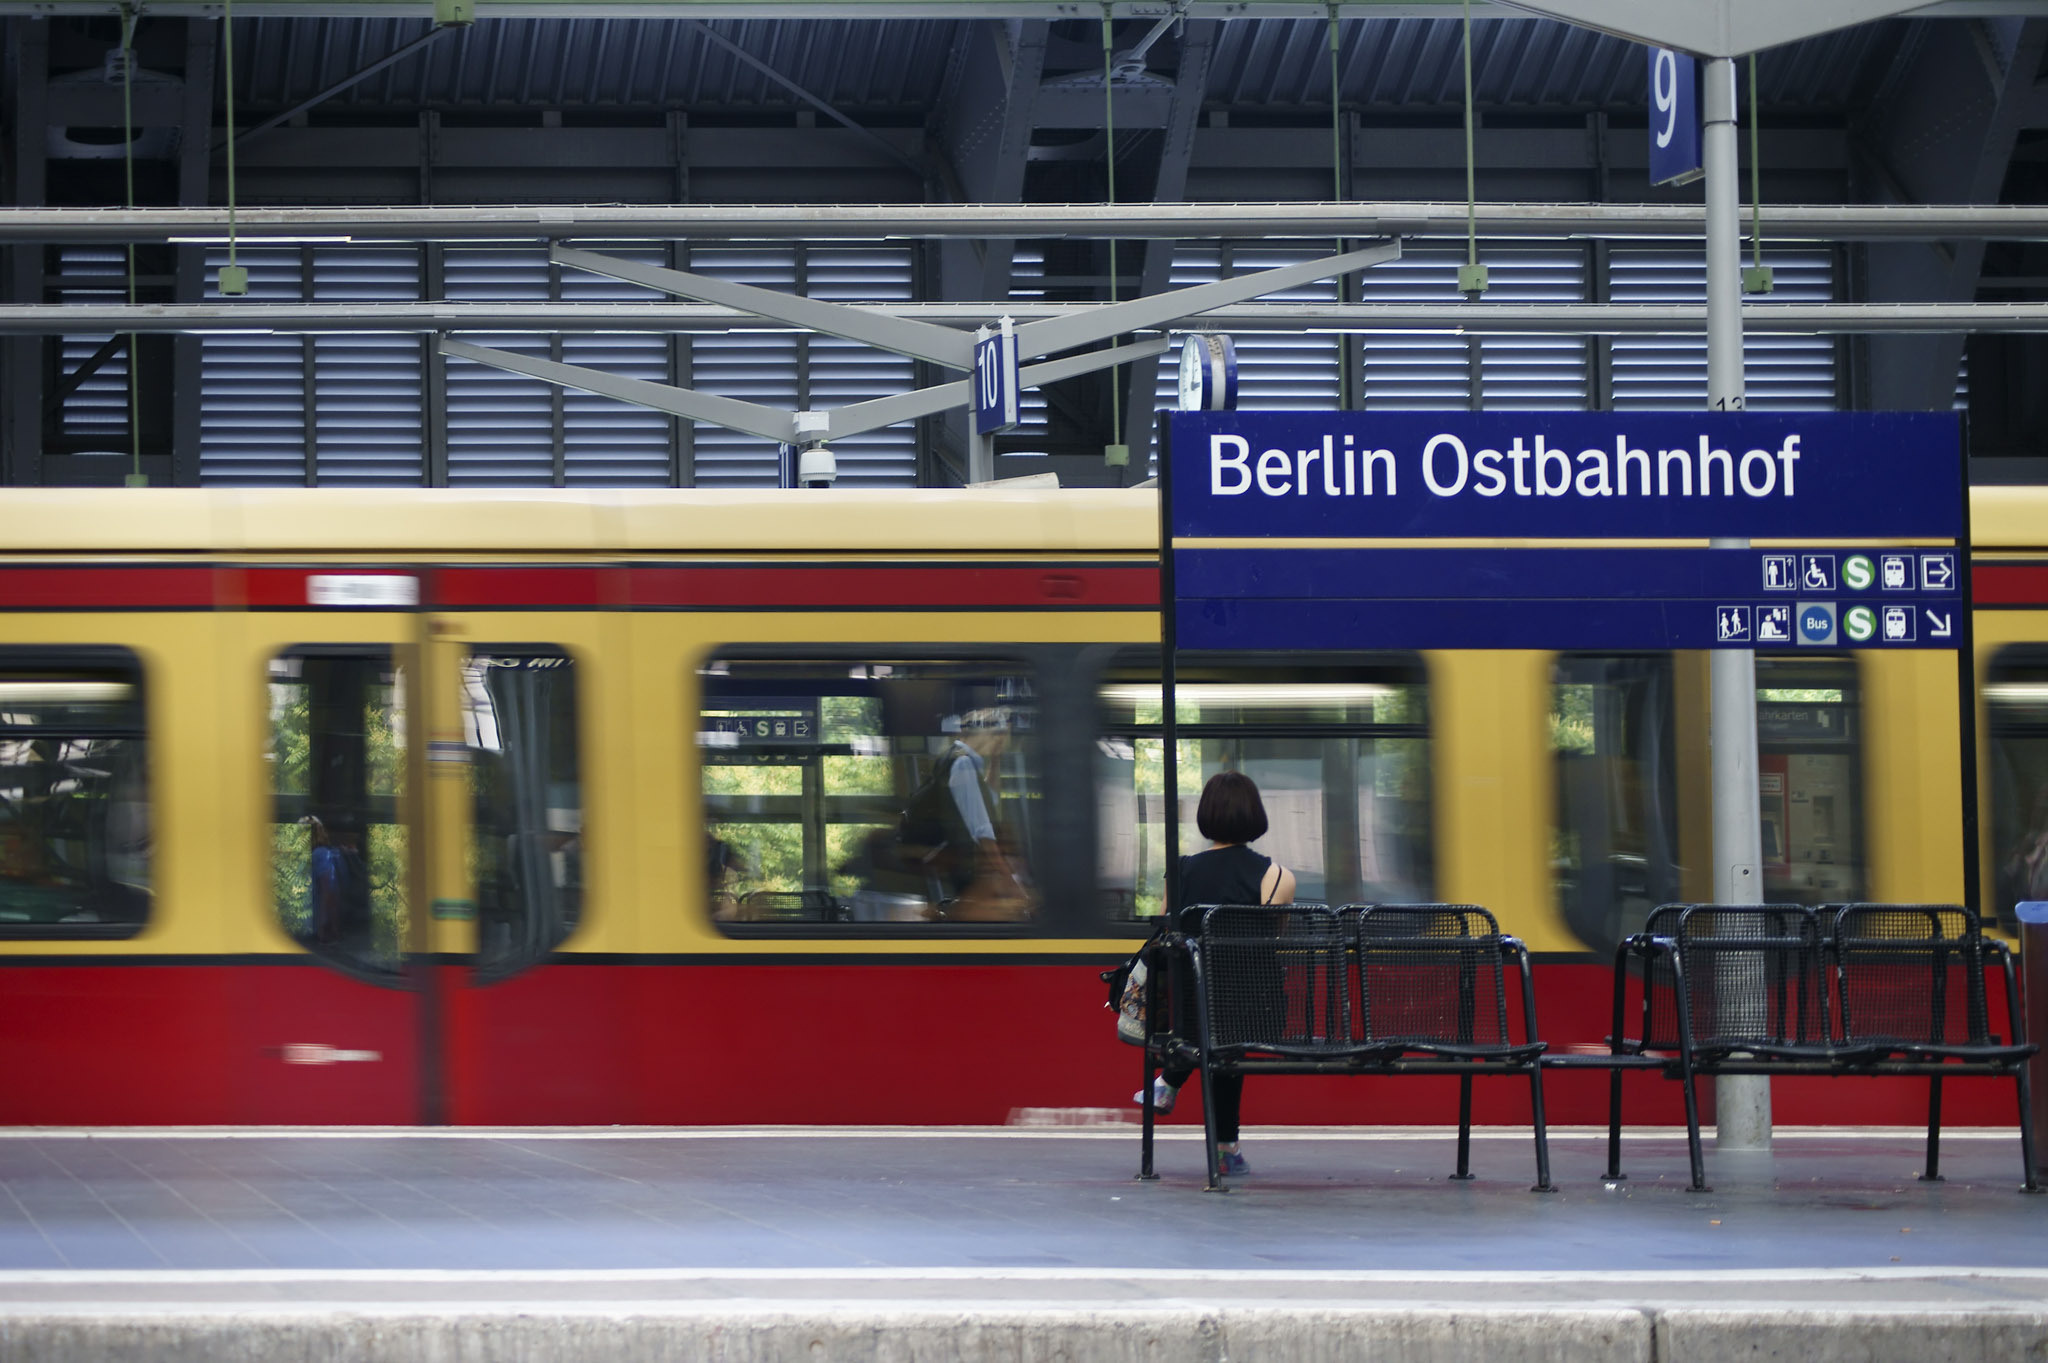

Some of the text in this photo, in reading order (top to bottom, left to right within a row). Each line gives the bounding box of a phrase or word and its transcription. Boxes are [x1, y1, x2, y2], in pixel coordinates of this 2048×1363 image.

[1654, 48, 1677, 149] 9
[977, 340, 998, 410] 10
[1210, 433, 1800, 497] Berlin Ostbahnhof
[1847, 557, 1871, 588] S
[1806, 617, 1828, 630] Bus
[1848, 608, 1872, 639] S
[1758, 710, 1809, 721] ahrkarten
